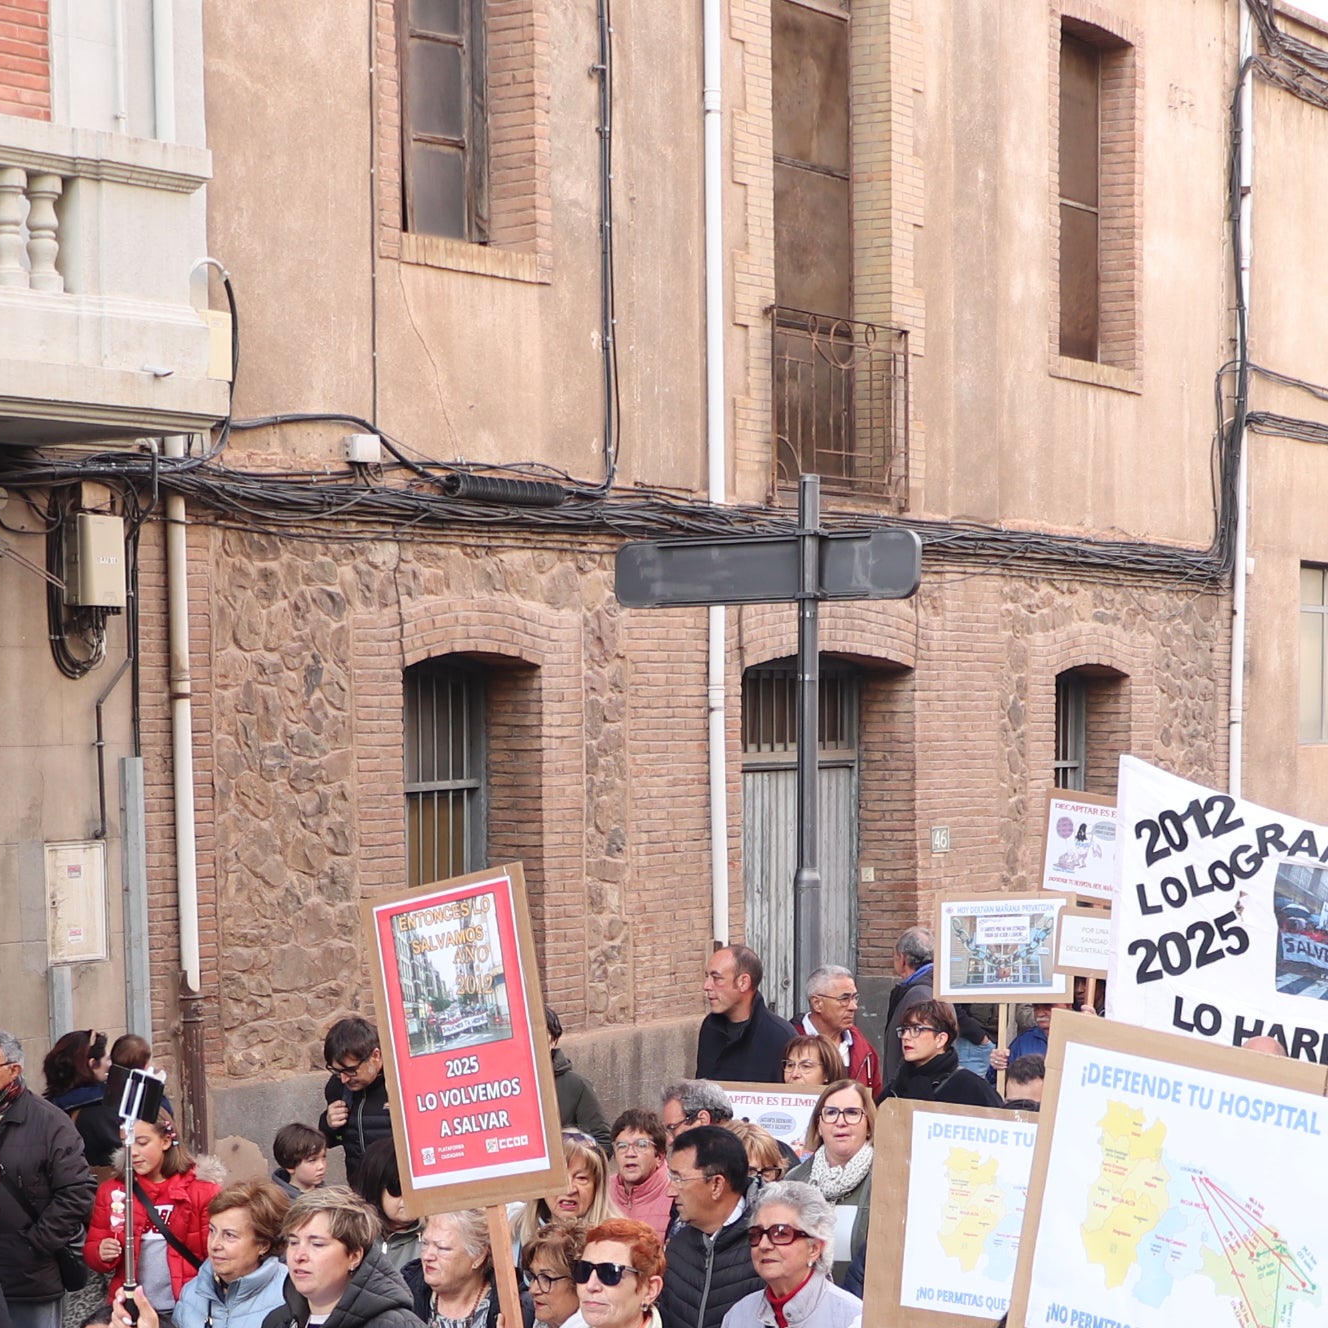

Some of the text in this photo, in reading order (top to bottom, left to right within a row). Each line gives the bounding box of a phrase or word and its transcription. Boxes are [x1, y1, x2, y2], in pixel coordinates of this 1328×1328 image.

[1055, 803, 1098, 815] DECAPITAR
[932, 829, 948, 849] 46
[1135, 795, 1244, 867] 2012
[995, 903, 1021, 914] MAÑANA
[1136, 877, 1187, 915] LO
[399, 896, 491, 932] ENTONCES LO
[411, 927, 484, 954] SALVAMOS
[1127, 911, 1249, 984] 2025
[455, 974, 494, 995] 2012
[1173, 996, 1222, 1036] LO
[445, 1055, 479, 1078] 2025
[416, 1077, 521, 1112] LO VOLVEMOS
[727, 1094, 818, 1107] APITAR ES ELIMIN
[1081, 1062, 1184, 1104] ¡DEFIENDE
[1187, 1084, 1214, 1111] TU
[1218, 1090, 1322, 1137] HOSPITAL
[439, 1110, 510, 1138] A SALVAR
[927, 1122, 1035, 1148] ¡DEFIENDE TU
[916, 1286, 1008, 1311] ¡NO PERMITAS QUE
[1045, 1303, 1068, 1325] ¡NO
